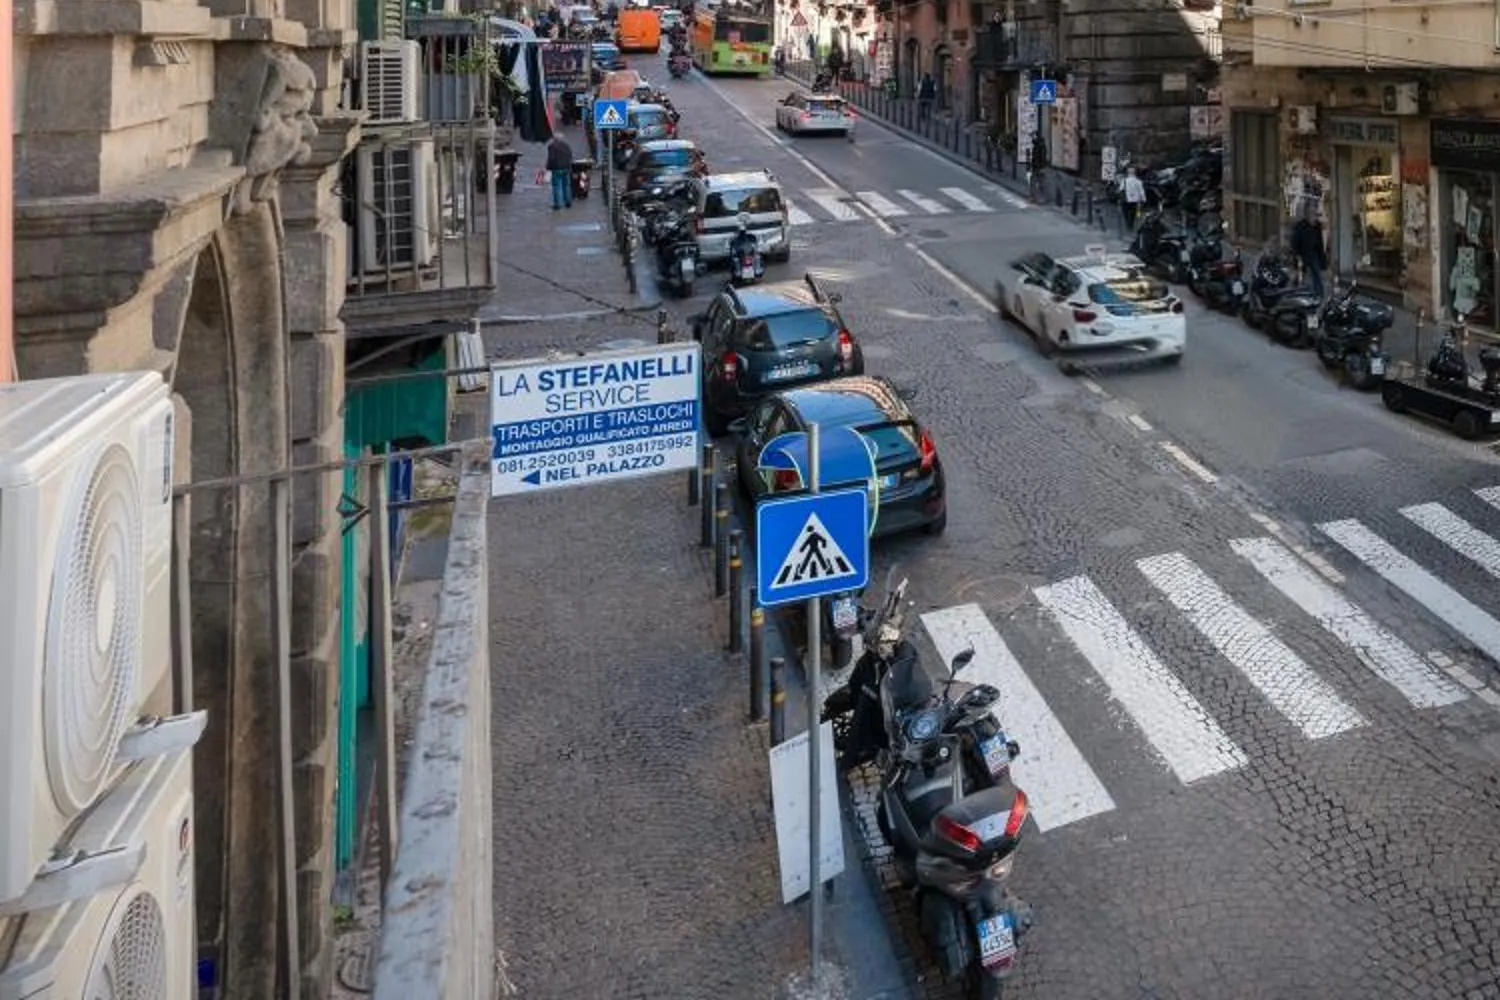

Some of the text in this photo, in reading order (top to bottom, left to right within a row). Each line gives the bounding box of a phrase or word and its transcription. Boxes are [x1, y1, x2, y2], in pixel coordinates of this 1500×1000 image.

[499, 355, 693, 397] LA STEFANELLI
[545, 383, 652, 414] SERVICE
[498, 402, 693, 441] TRASPORTI E TRASLOCHI
[501, 420, 693, 454] MONTAGGIO QUALIFICATO ARREDI
[498, 449, 595, 473] 081.2520039
[546, 454, 665, 483] NEL PALAZZO
